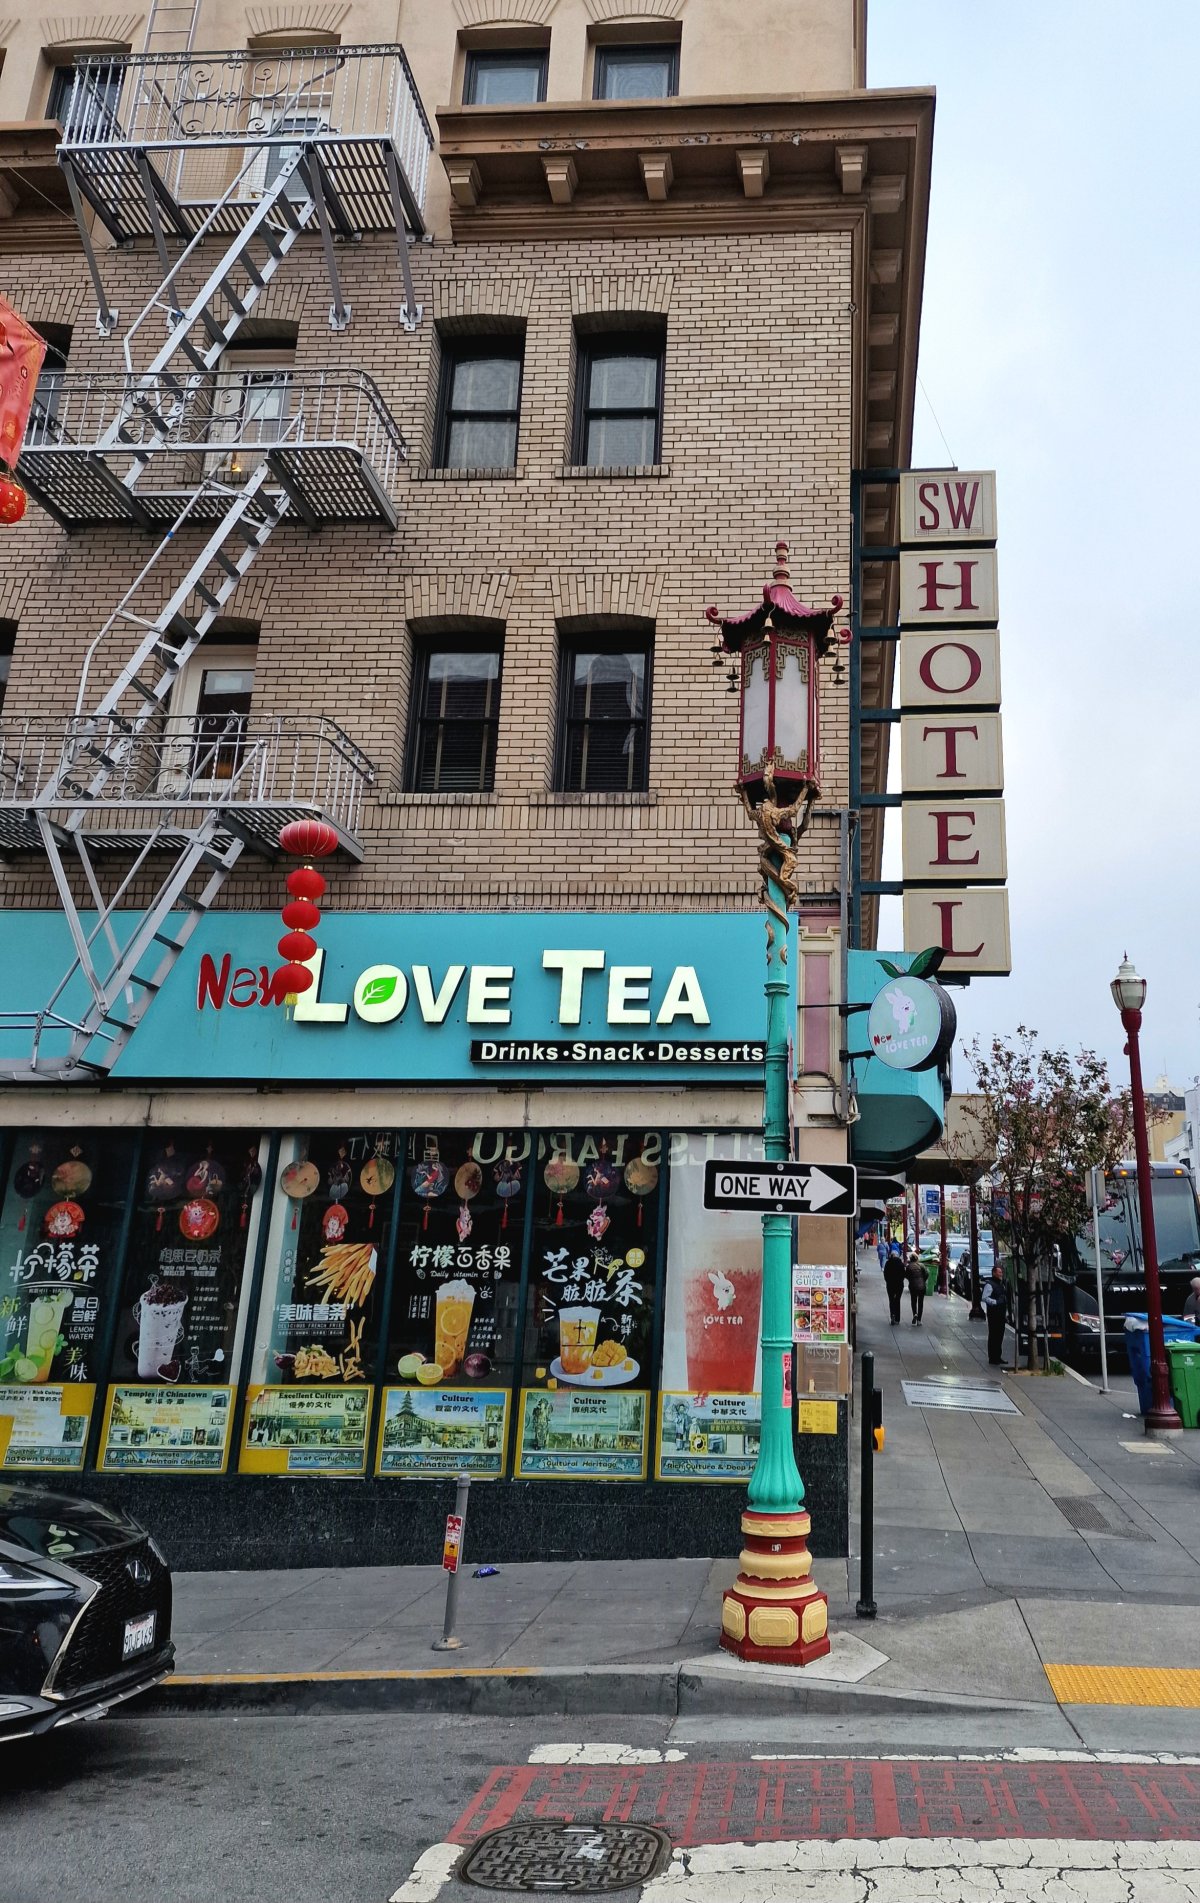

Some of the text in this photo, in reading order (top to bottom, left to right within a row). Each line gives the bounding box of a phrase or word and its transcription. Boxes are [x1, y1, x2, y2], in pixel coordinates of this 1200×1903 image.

[919, 482, 980, 529] SW
[918, 561, 985, 957] HOTEL
[293, 948, 514, 1024] LOVE
[542, 949, 711, 1025] TEA
[873, 1034, 892, 1046] New
[885, 1035, 928, 1053] LOVE TEA
[658, 1043, 764, 1061] Desserts
[720, 1175, 810, 1198] ONE WAY
[9, 1242, 100, 1282] 柠檬茶
[409, 1244, 511, 1270] 柠檬百香果
[430, 1271, 449, 1279] Daily
[796, 1278, 824, 1286] GUIDE
[69, 1325, 95, 1334] LEMON
[703, 1315, 743, 1326] LOVE TEA
[711, 1408, 747, 1416] 中華文化
